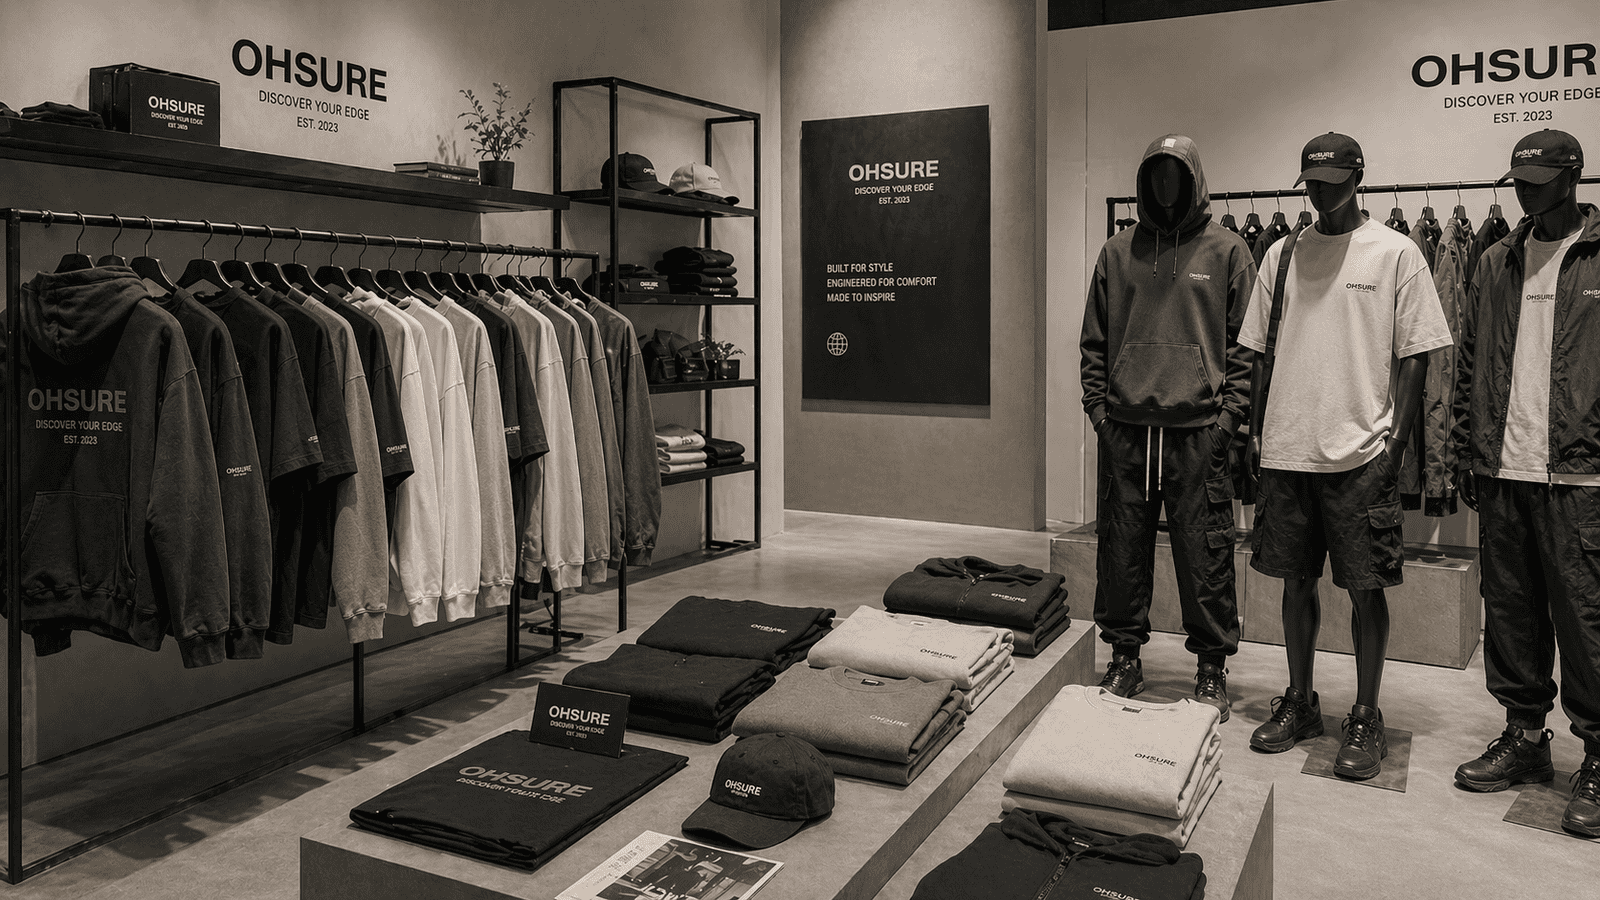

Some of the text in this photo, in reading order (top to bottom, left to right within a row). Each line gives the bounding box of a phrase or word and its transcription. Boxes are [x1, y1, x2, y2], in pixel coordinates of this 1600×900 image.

[232, 39, 387, 102] OHSURE
[148, 95, 205, 116] OHSURE
[259, 90, 370, 121] DISCOVER YOUR EDGE
[1444, 87, 1600, 109] DISCOVER YOUR EDGE
[297, 116, 339, 133] EST. 2023
[1493, 110, 1553, 124] EST. 2023
[848, 159, 940, 182] OHSURE
[854, 182, 934, 196] DISCOVER YOUR EDGE
[878, 195, 910, 205] EST. 2023
[827, 262, 894, 274] BUILT FOR STYLE
[827, 276, 937, 288] ENGINEERED FOR COMFORT
[1345, 282, 1377, 292] OHSURE
[827, 292, 896, 302] MADE TO INSPIRE
[28, 388, 127, 413] OHSURE
[35, 419, 123, 432] DISCOVER YOUR EDGE
[63, 435, 98, 445] EST. 2023
[548, 705, 611, 726] OHSURE
[458, 766, 594, 797] OHSURE
[724, 779, 762, 797] OHSURE
[1093, 886, 1140, 900] OHSUR
